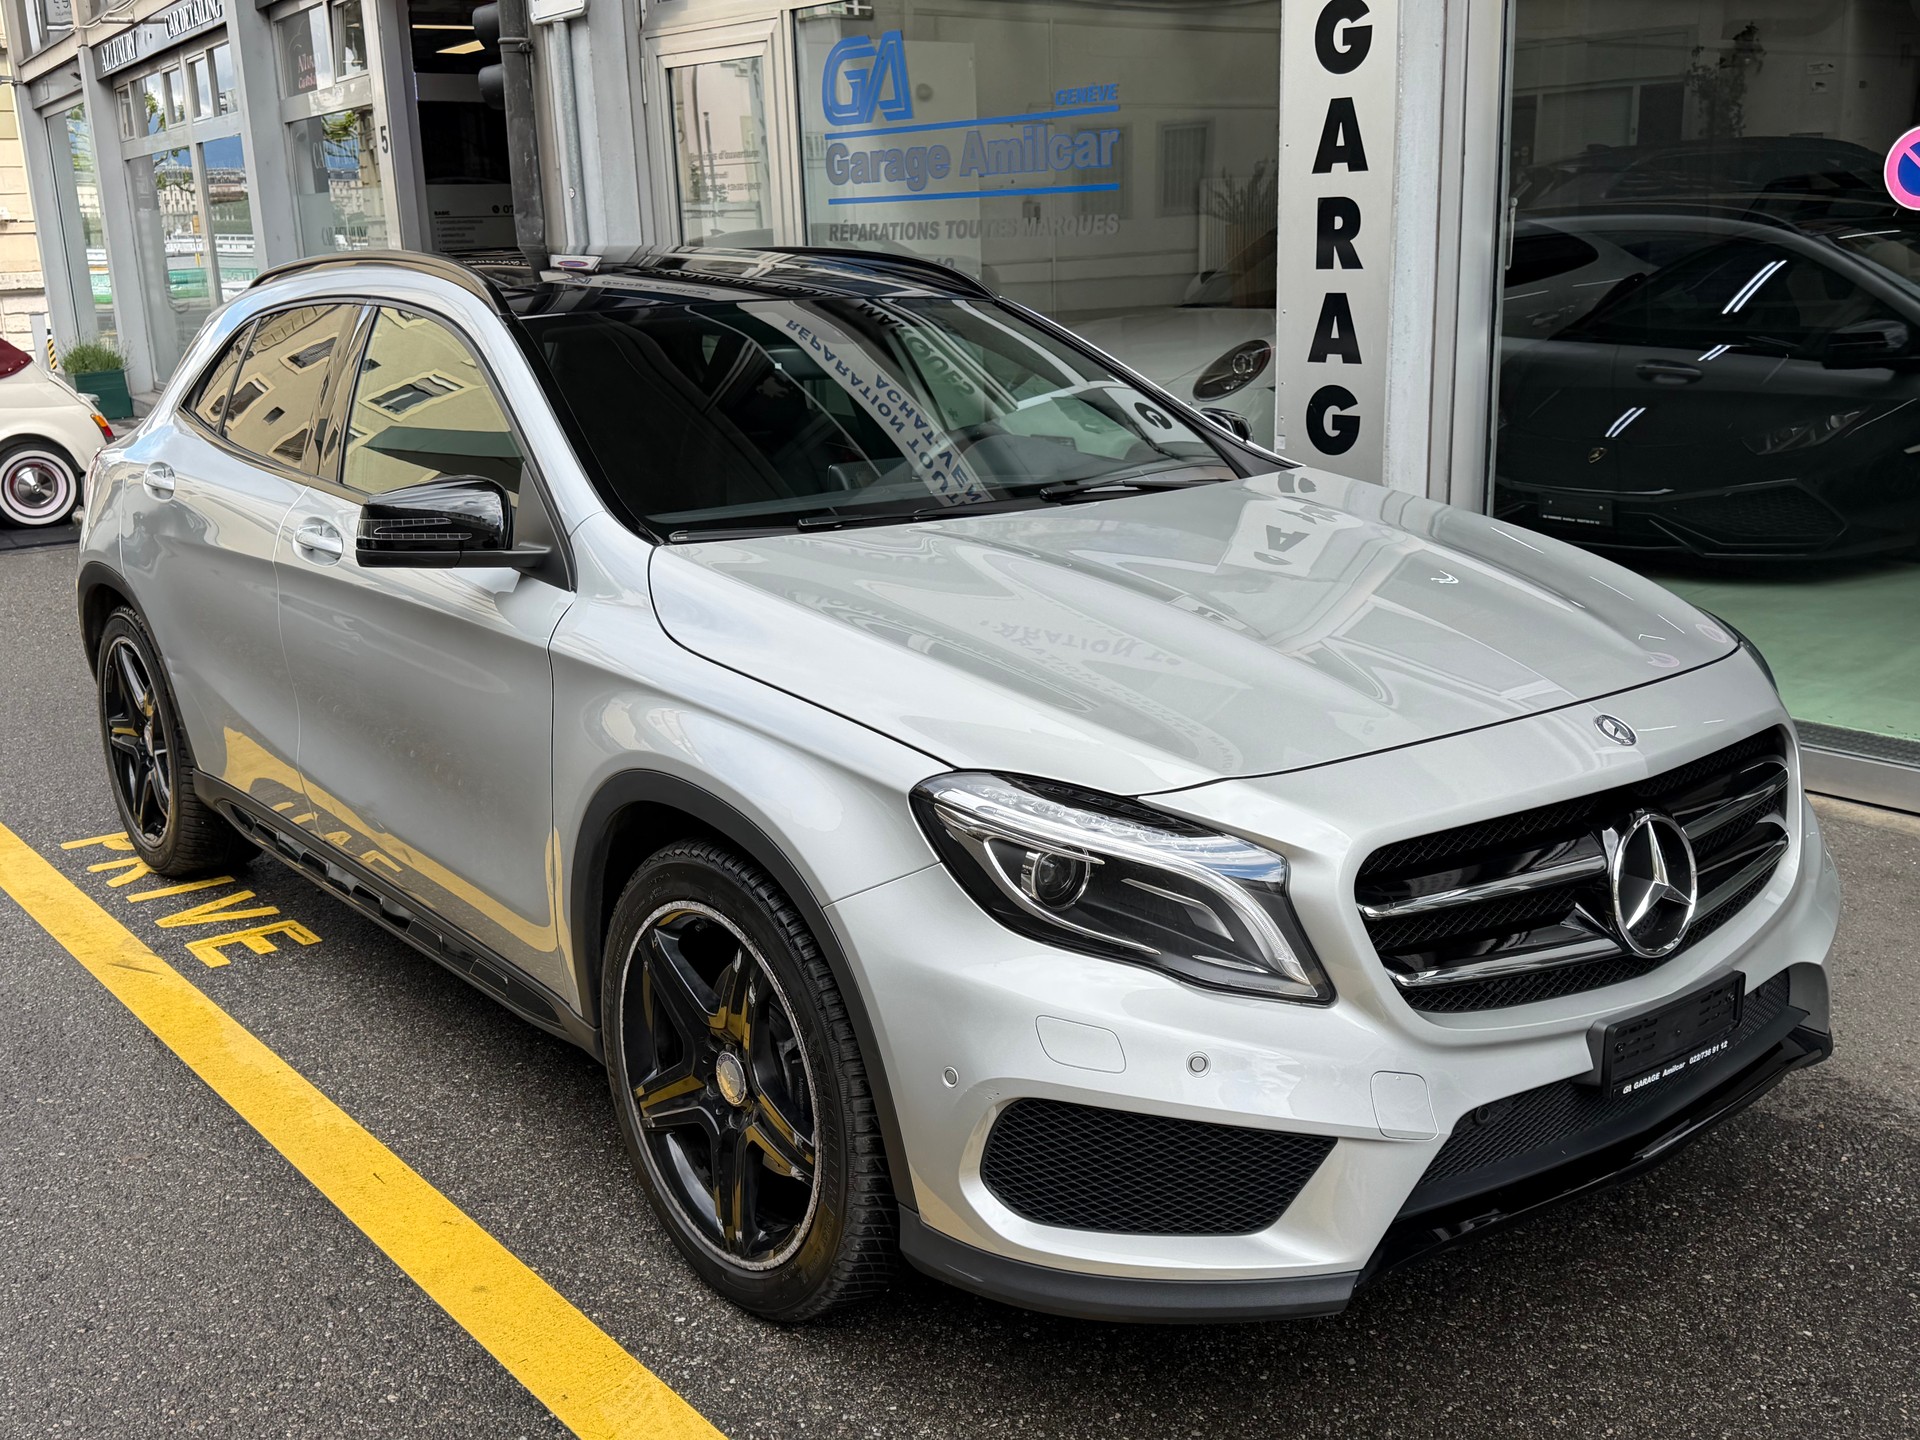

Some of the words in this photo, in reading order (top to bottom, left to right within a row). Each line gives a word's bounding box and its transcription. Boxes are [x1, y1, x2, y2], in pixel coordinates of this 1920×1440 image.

[822, 30, 913, 126] GA
[1055, 81, 1120, 106] GENÈVE
[380, 125, 389, 154] 5
[825, 142, 951, 192] Garage
[959, 123, 1120, 177] Amilcar
[829, 219, 940, 242] RÉPARATIONS
[944, 217, 1018, 240] TOUTES
[1024, 213, 1120, 237] MARQUES
[1633, 1072, 1661, 1090] GARAGE
[1662, 1061, 1686, 1077] Amilcar
[1720, 1040, 1729, 1050] 12
